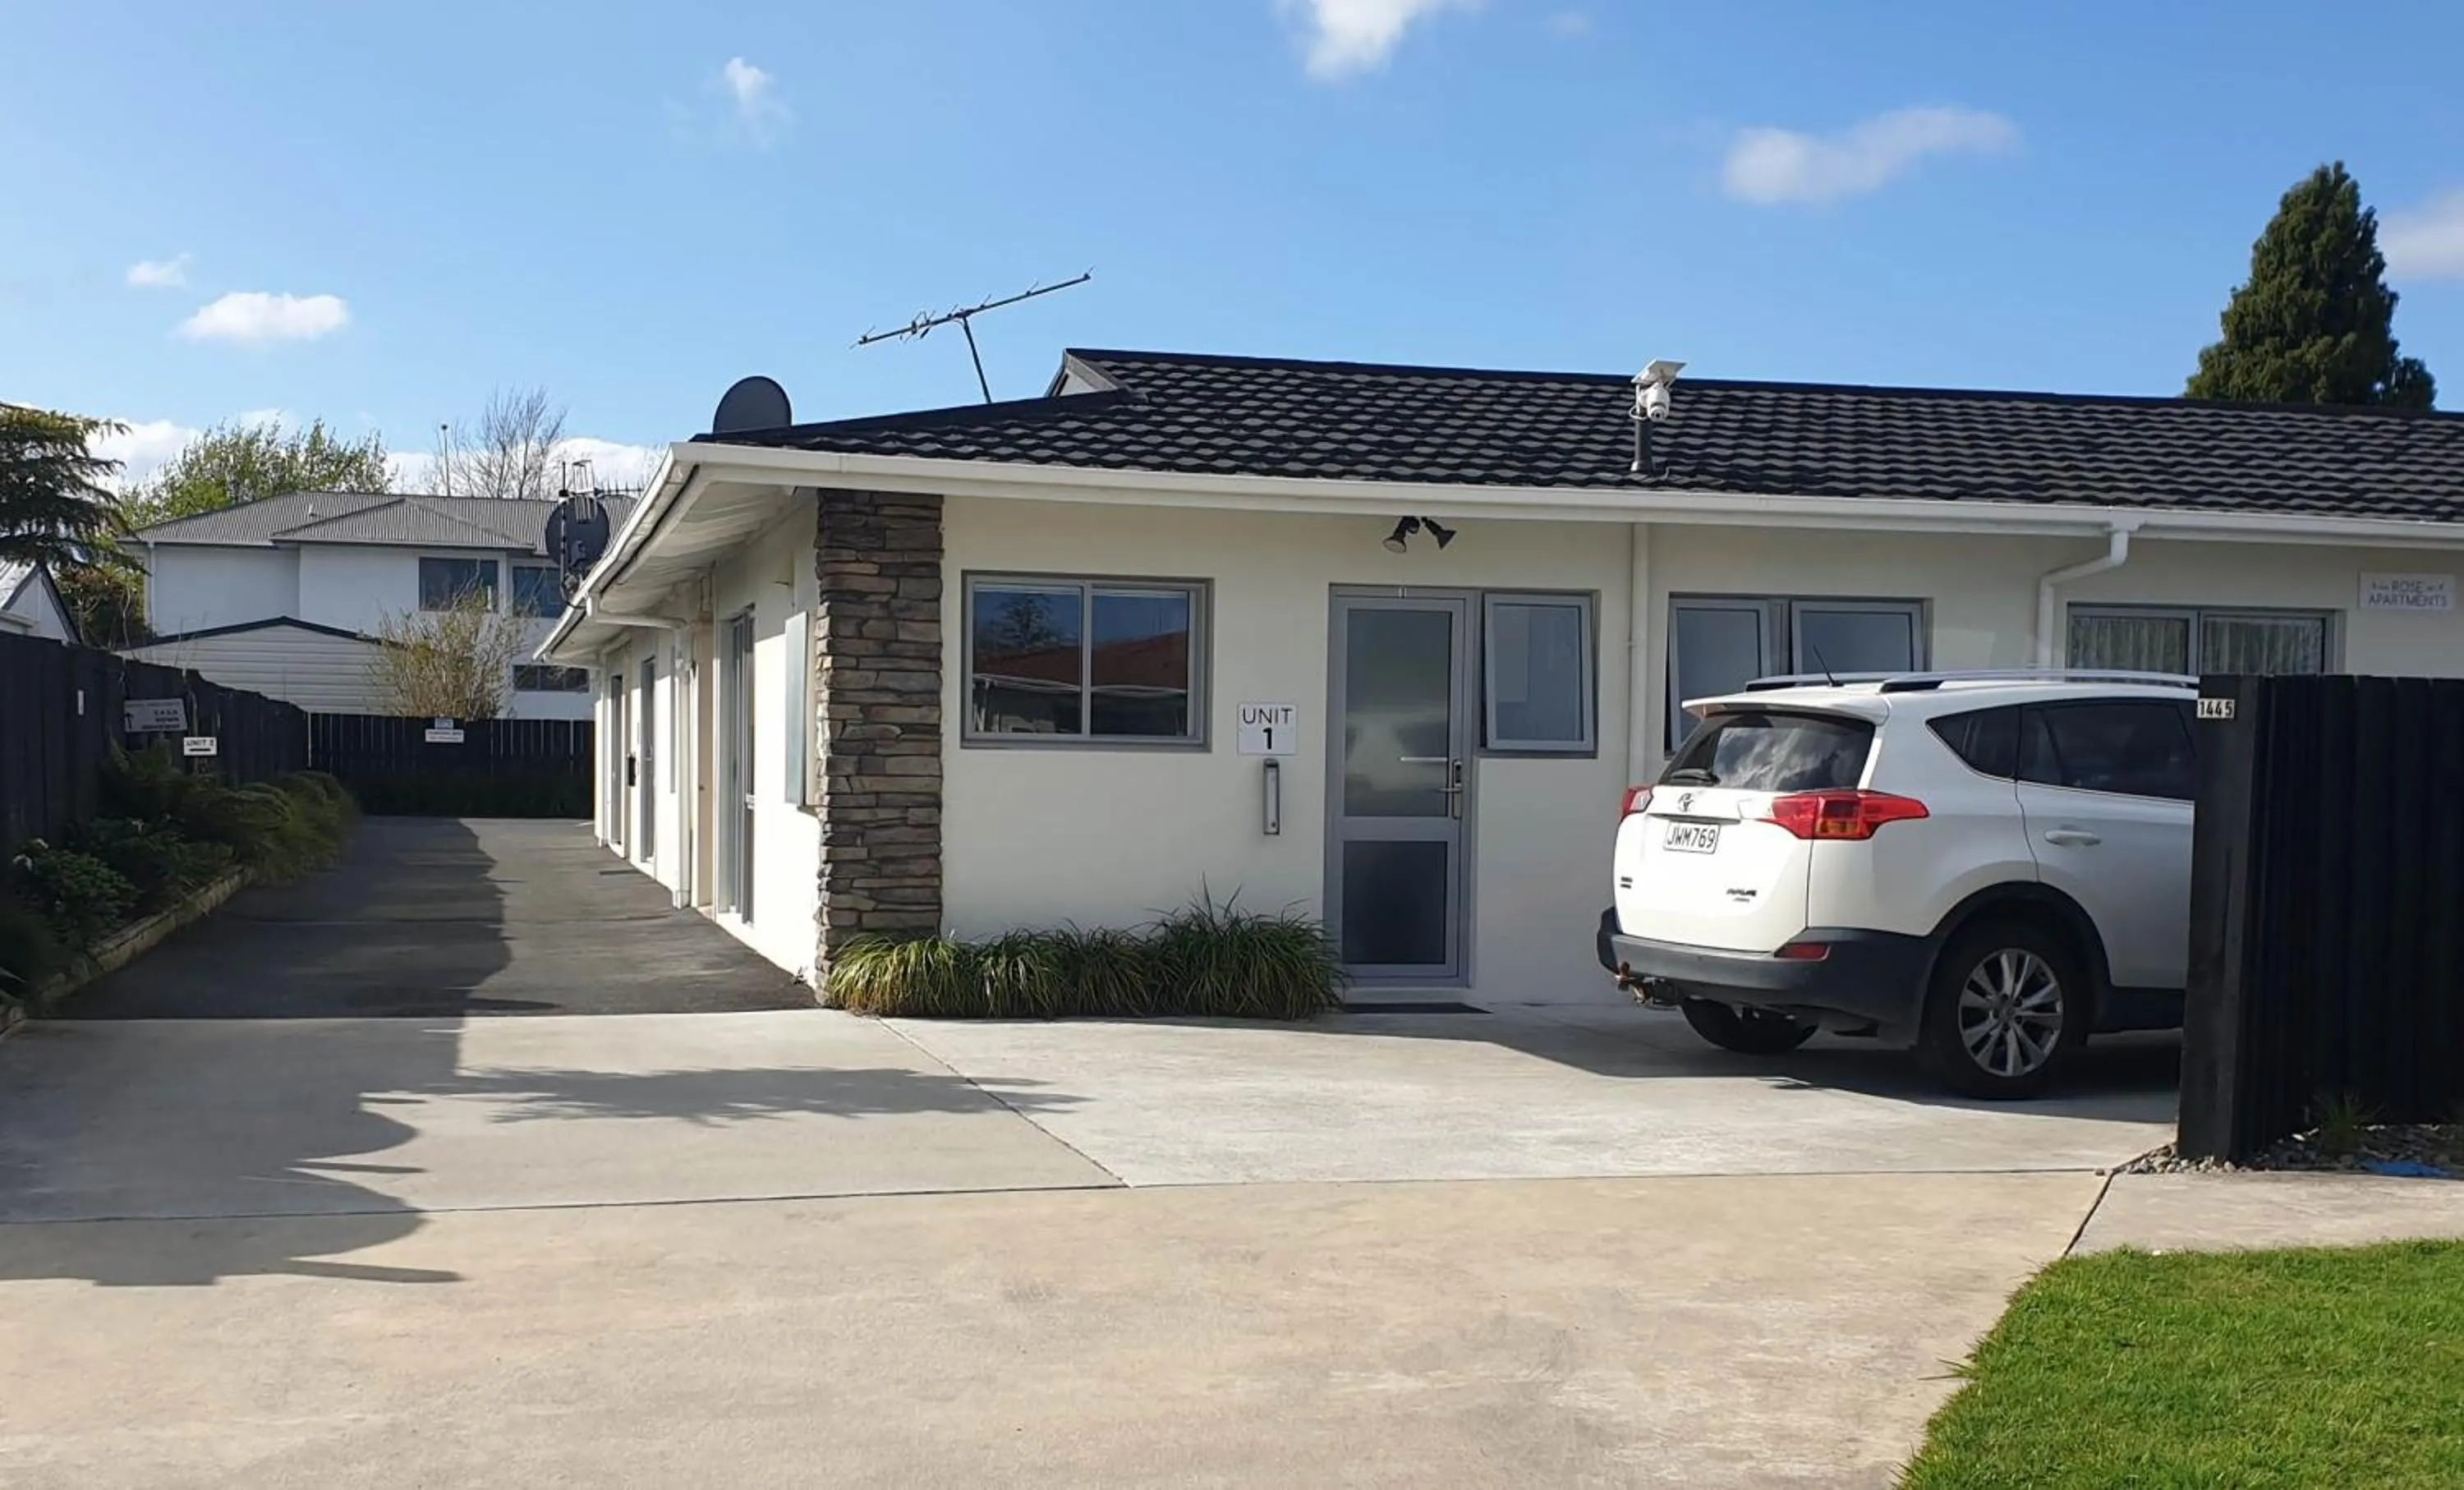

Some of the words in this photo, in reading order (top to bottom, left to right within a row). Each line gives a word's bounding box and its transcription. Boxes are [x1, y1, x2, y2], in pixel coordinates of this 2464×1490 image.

[2391, 580, 2424, 593] ROSE
[2369, 594, 2448, 606] APARTMENTS
[1242, 708, 1293, 724] UNIT
[2200, 701, 2233, 717] 1445
[1262, 727, 1273, 750] 1
[1666, 827, 1716, 848] JWM769
